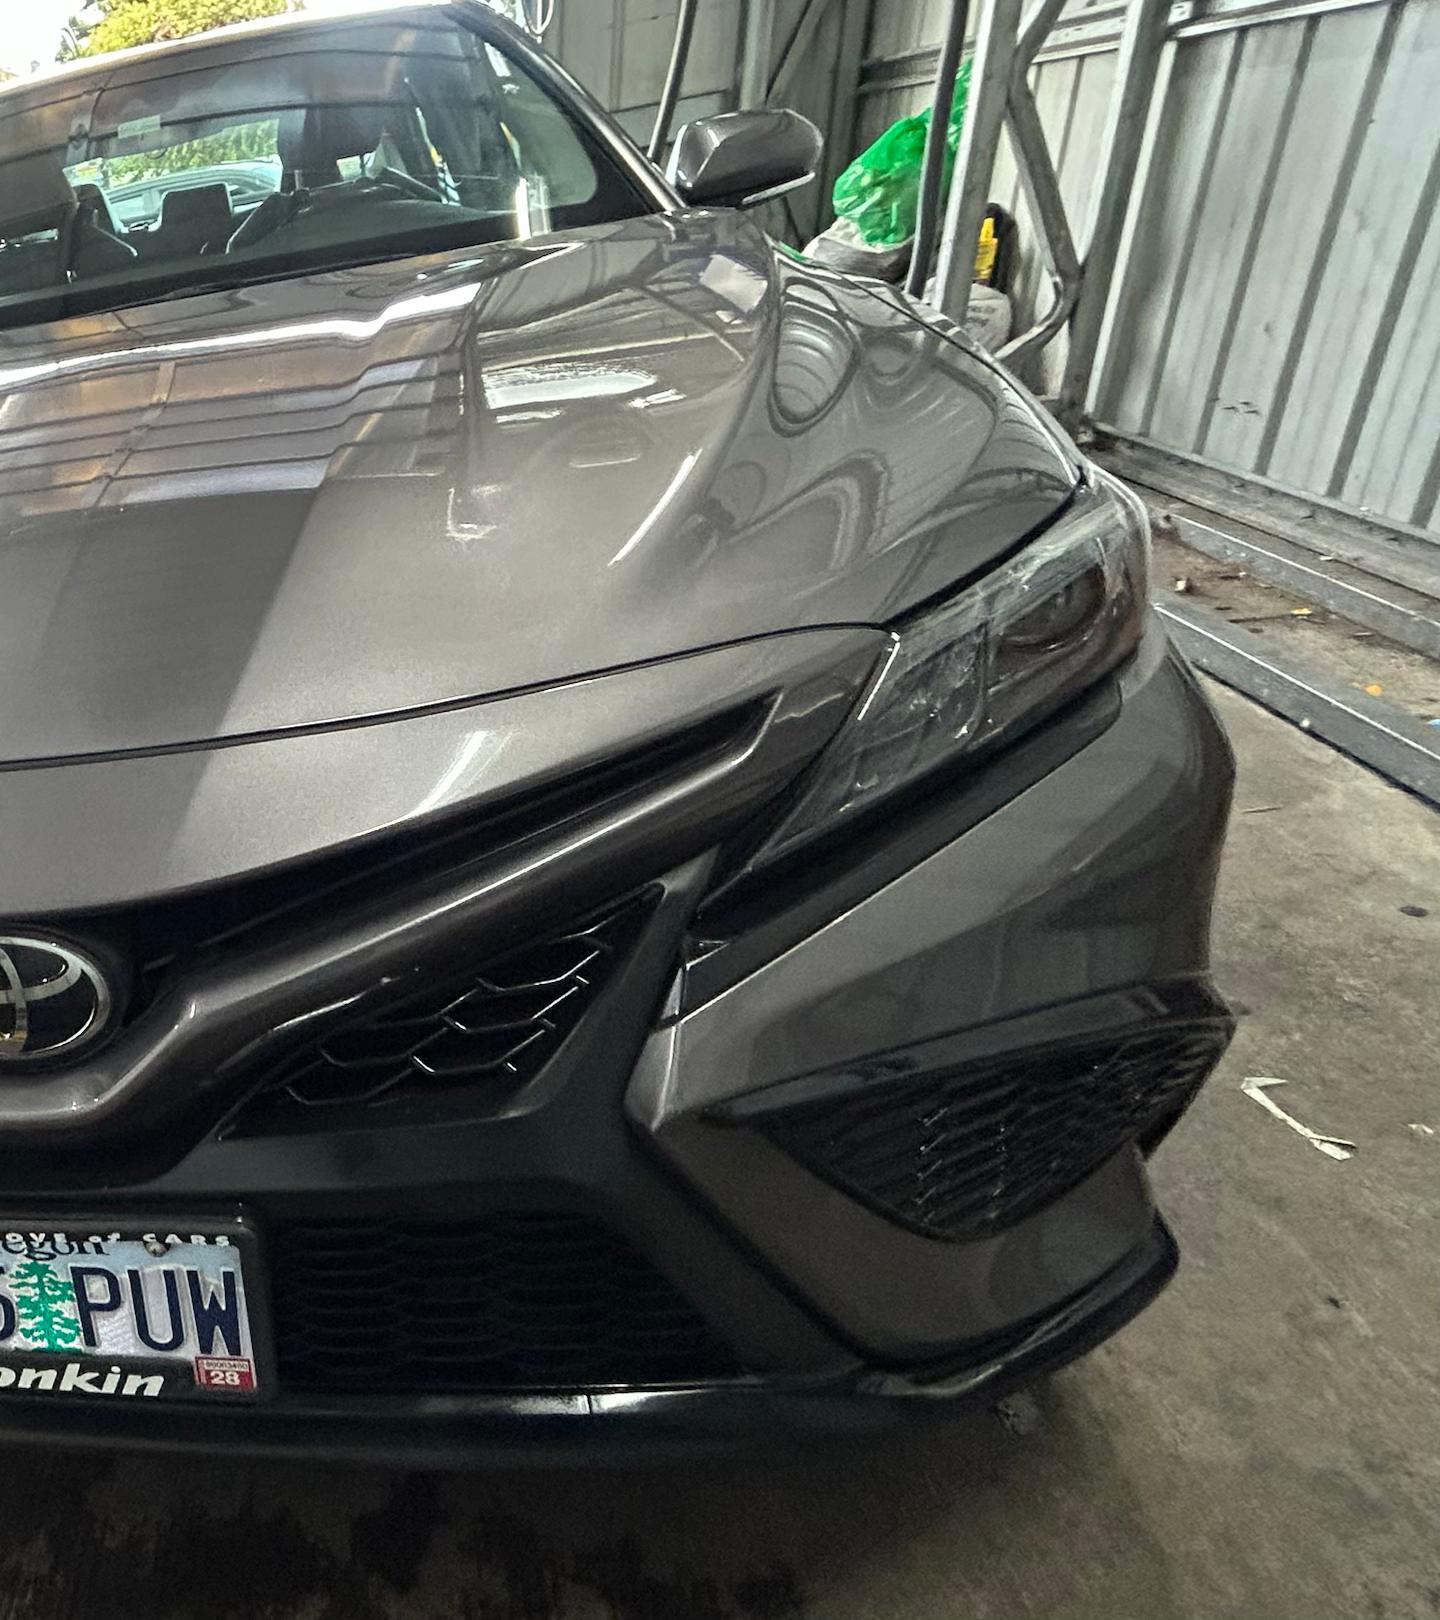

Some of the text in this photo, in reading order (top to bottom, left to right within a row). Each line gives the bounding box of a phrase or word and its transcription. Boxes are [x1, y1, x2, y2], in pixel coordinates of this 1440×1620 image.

[142, 1233, 231, 1247] CARS
[69, 1265, 242, 1356] PUW
[210, 1370, 241, 1386] 28
